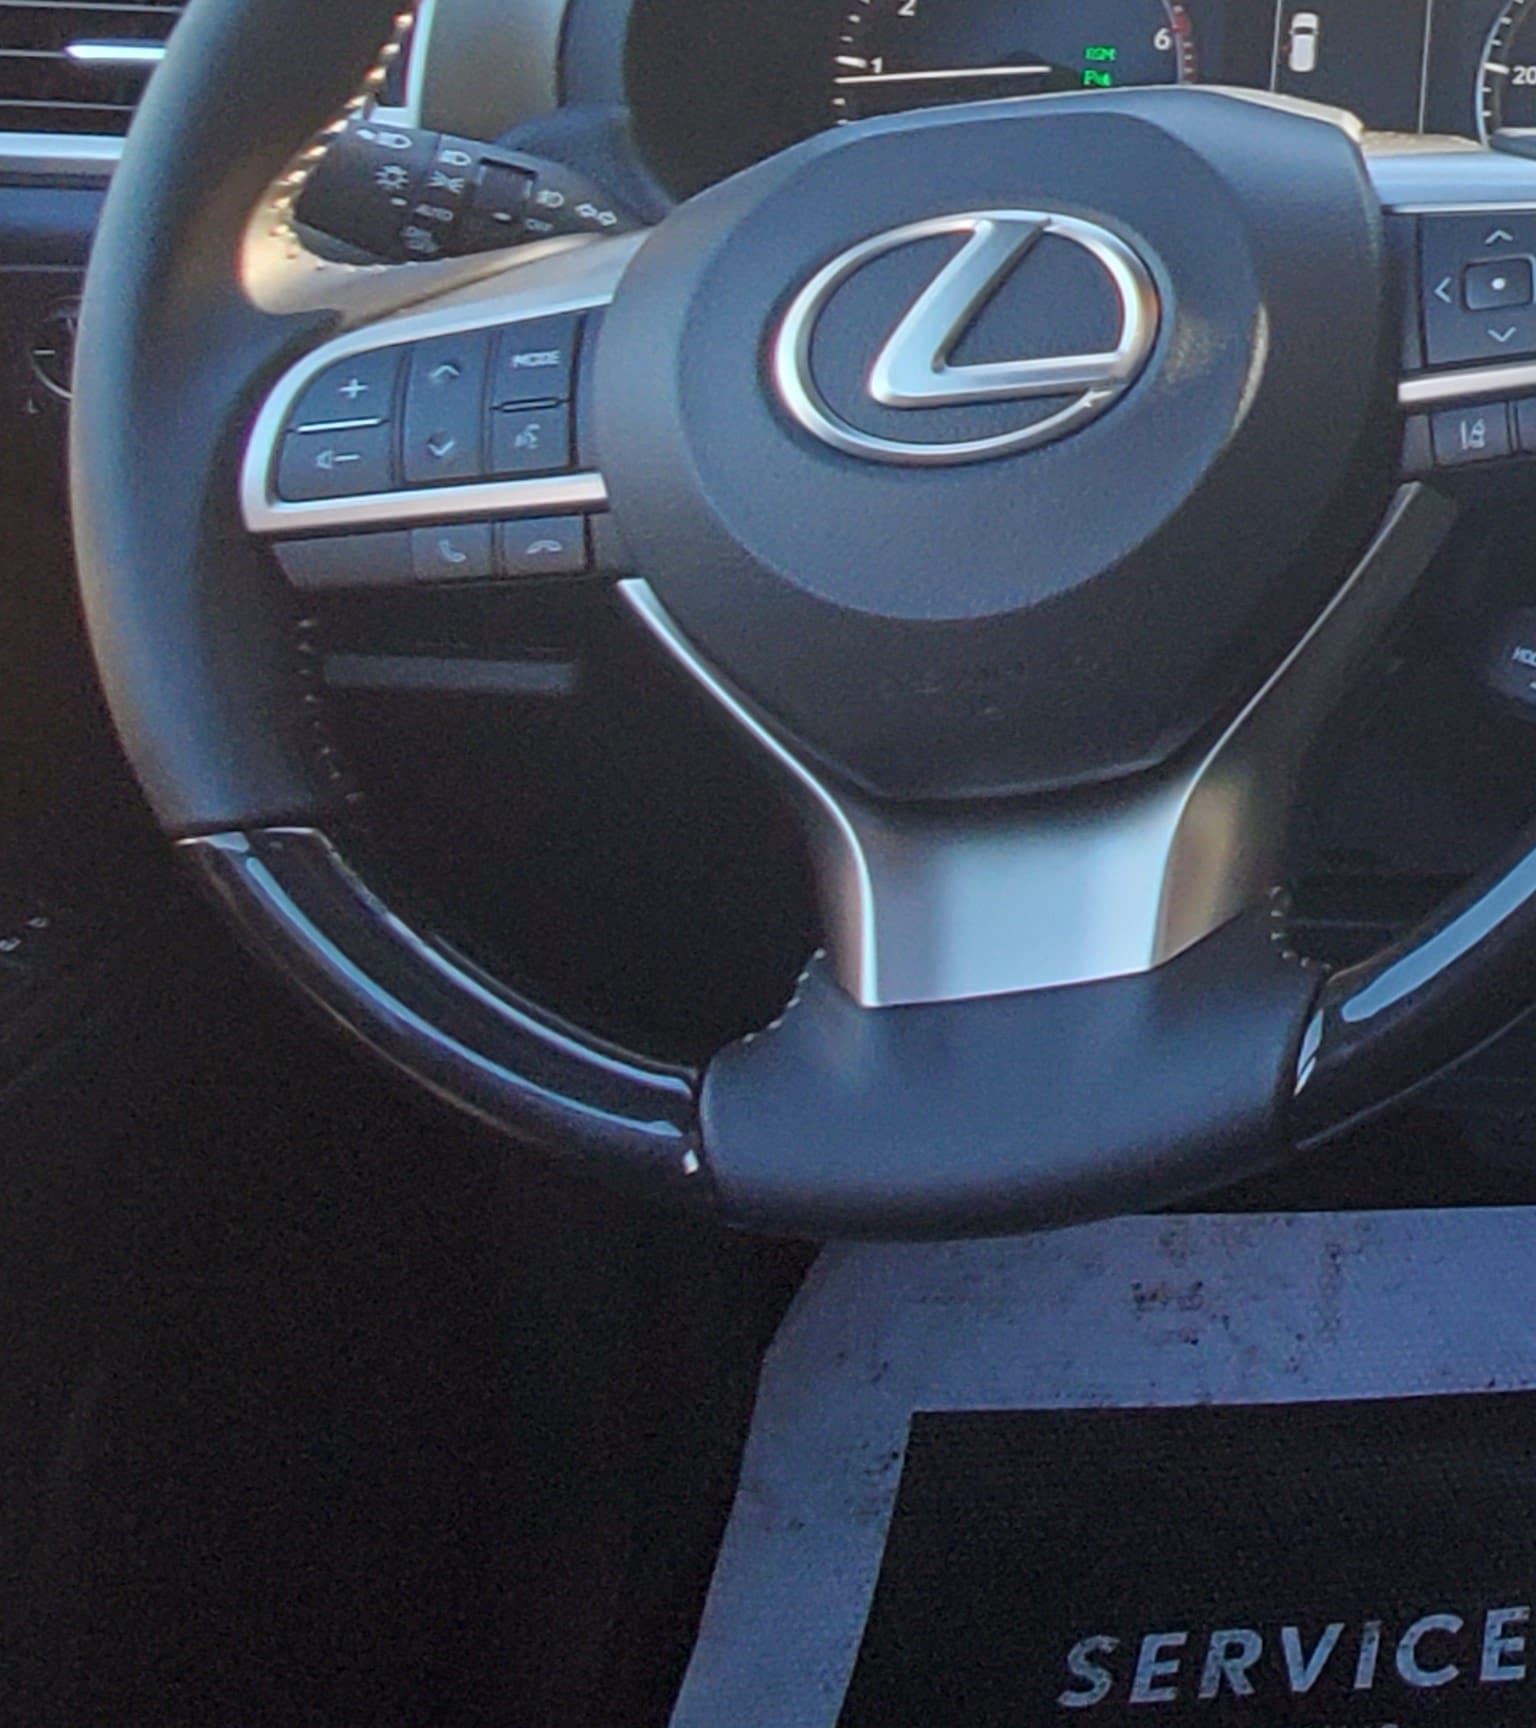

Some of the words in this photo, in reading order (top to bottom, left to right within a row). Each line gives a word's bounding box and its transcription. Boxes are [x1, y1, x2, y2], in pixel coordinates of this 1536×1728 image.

[1154, 28, 1171, 51] 6
[511, 349, 561, 368] MODE
[1056, 1605, 1532, 1708] SERVICE
